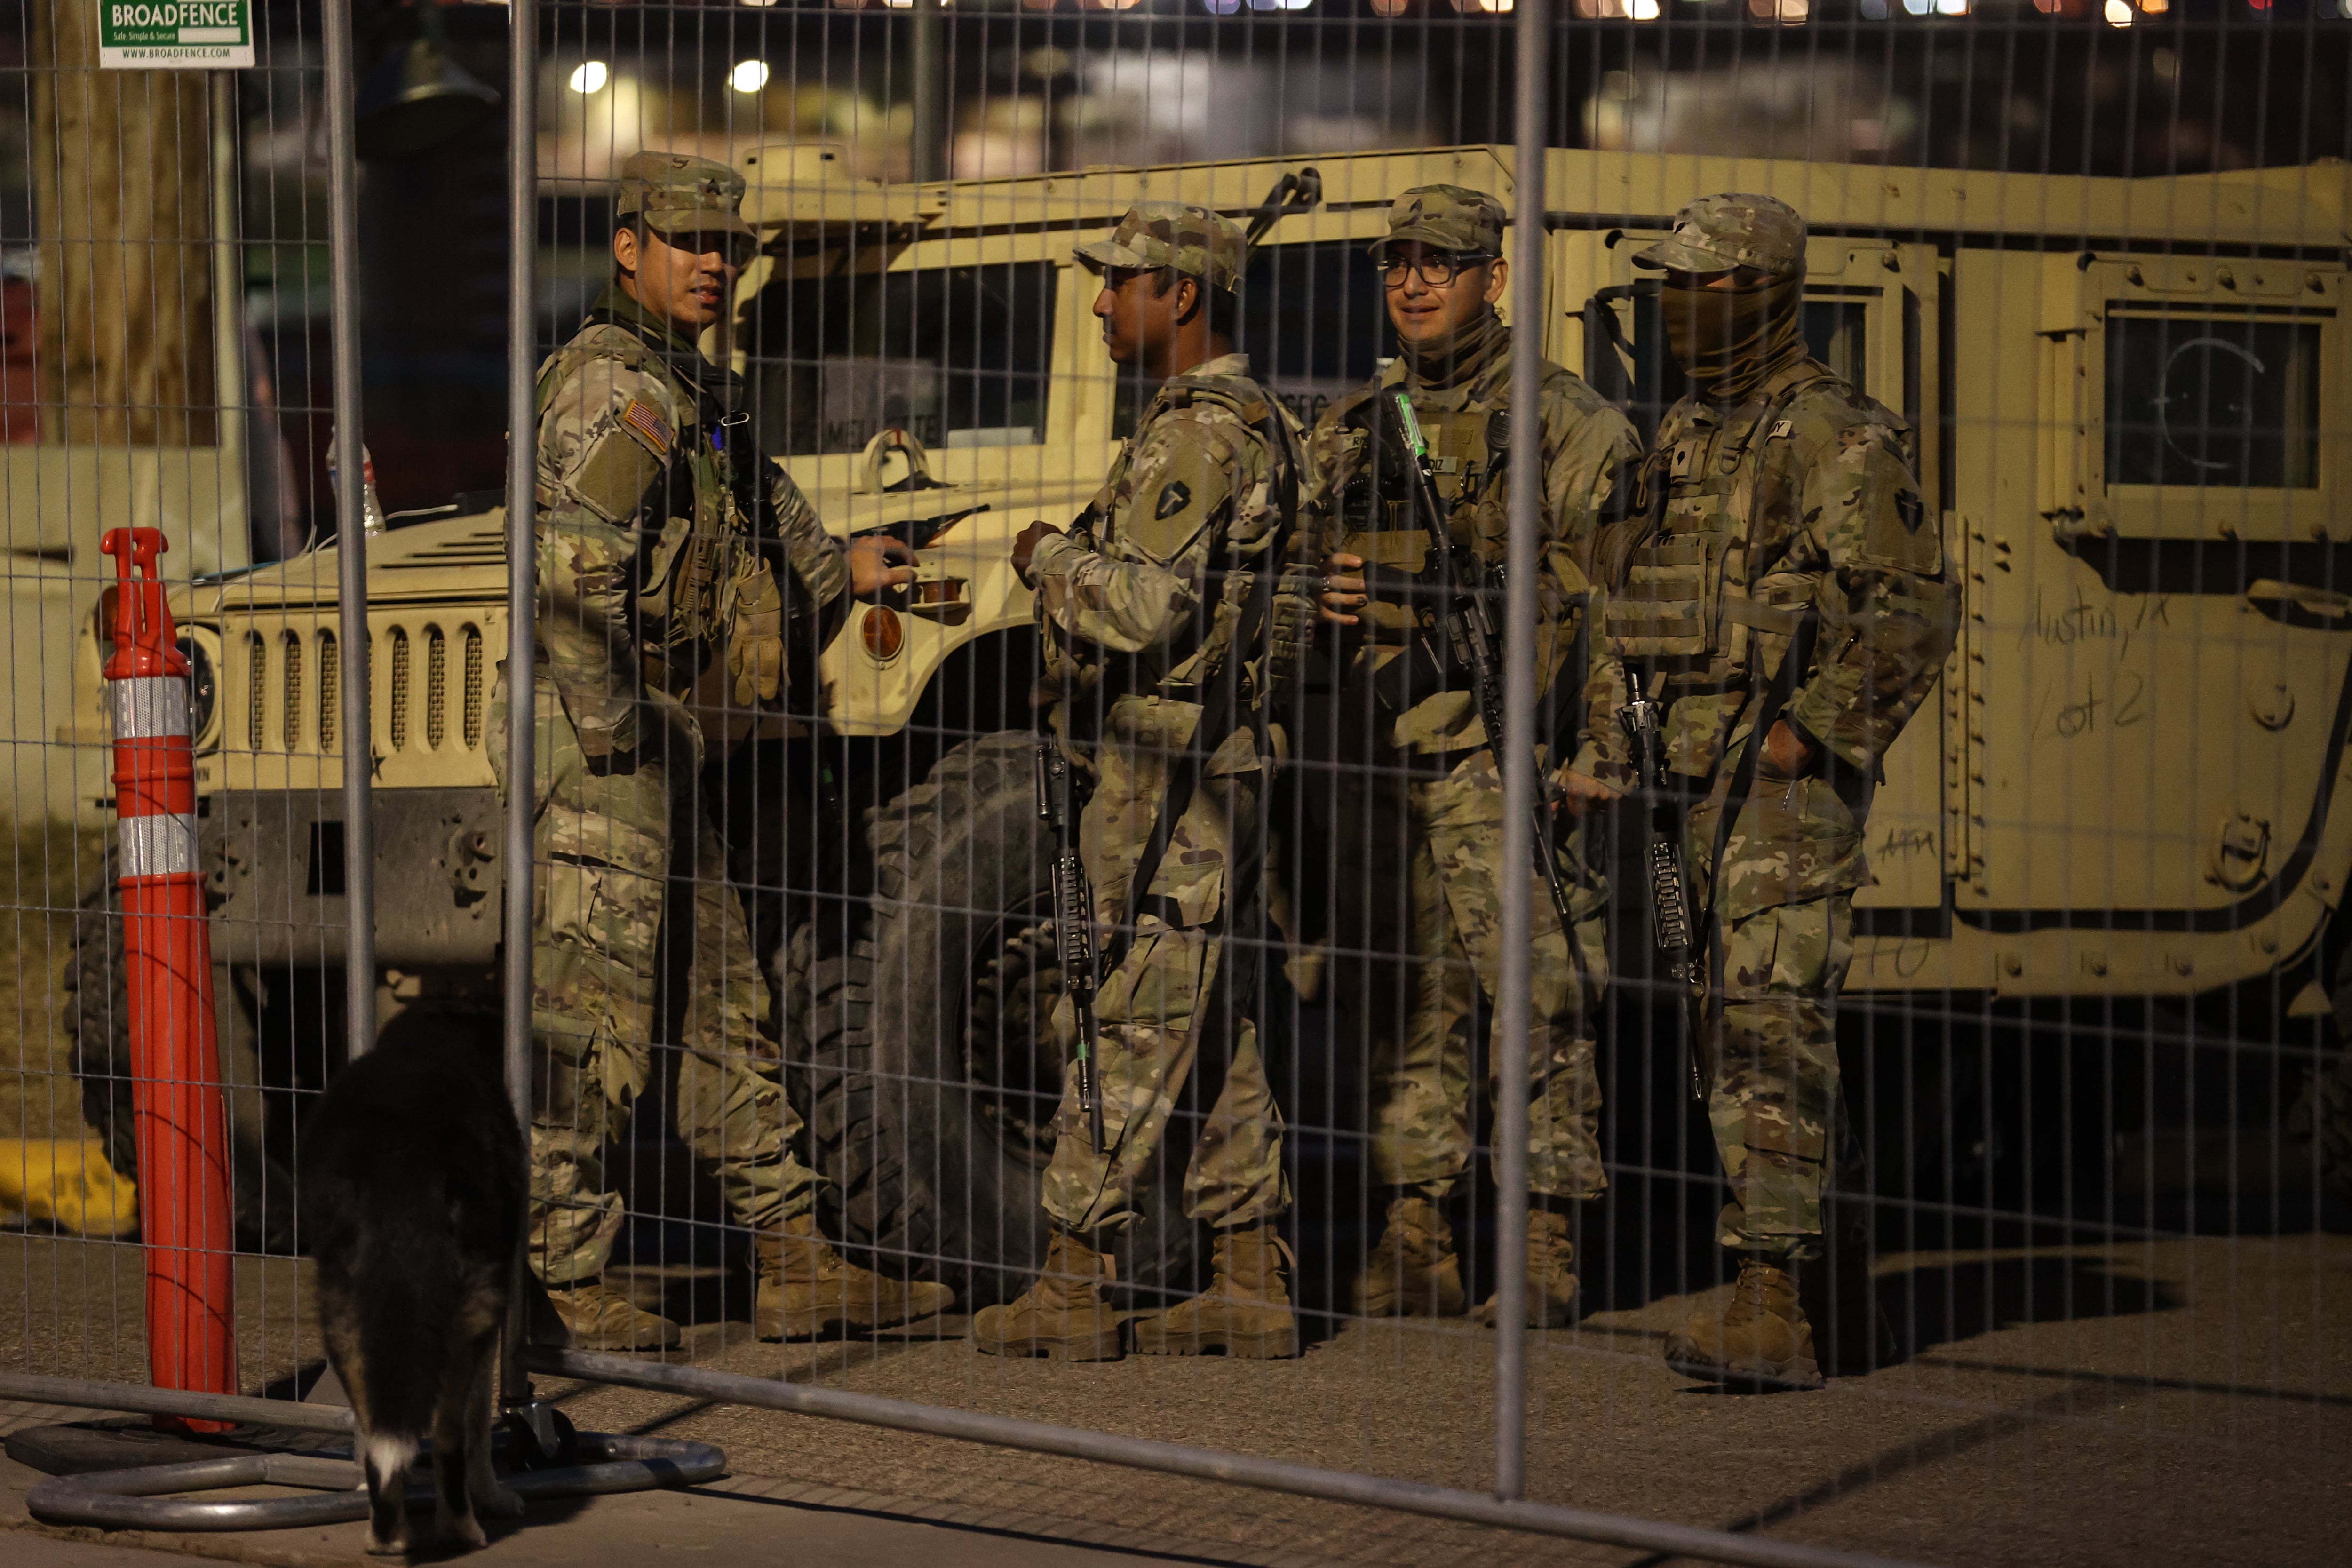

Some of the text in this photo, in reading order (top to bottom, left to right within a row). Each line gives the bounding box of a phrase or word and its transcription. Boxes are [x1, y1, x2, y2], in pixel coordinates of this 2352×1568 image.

[112, 3, 238, 27] BROADFENCE
[114, 31, 175, 42] Safe, Simple & Secure
[122, 48, 230, 58] WWW.BROADFENCE.COM
[2114, 669, 2145, 727] 2
